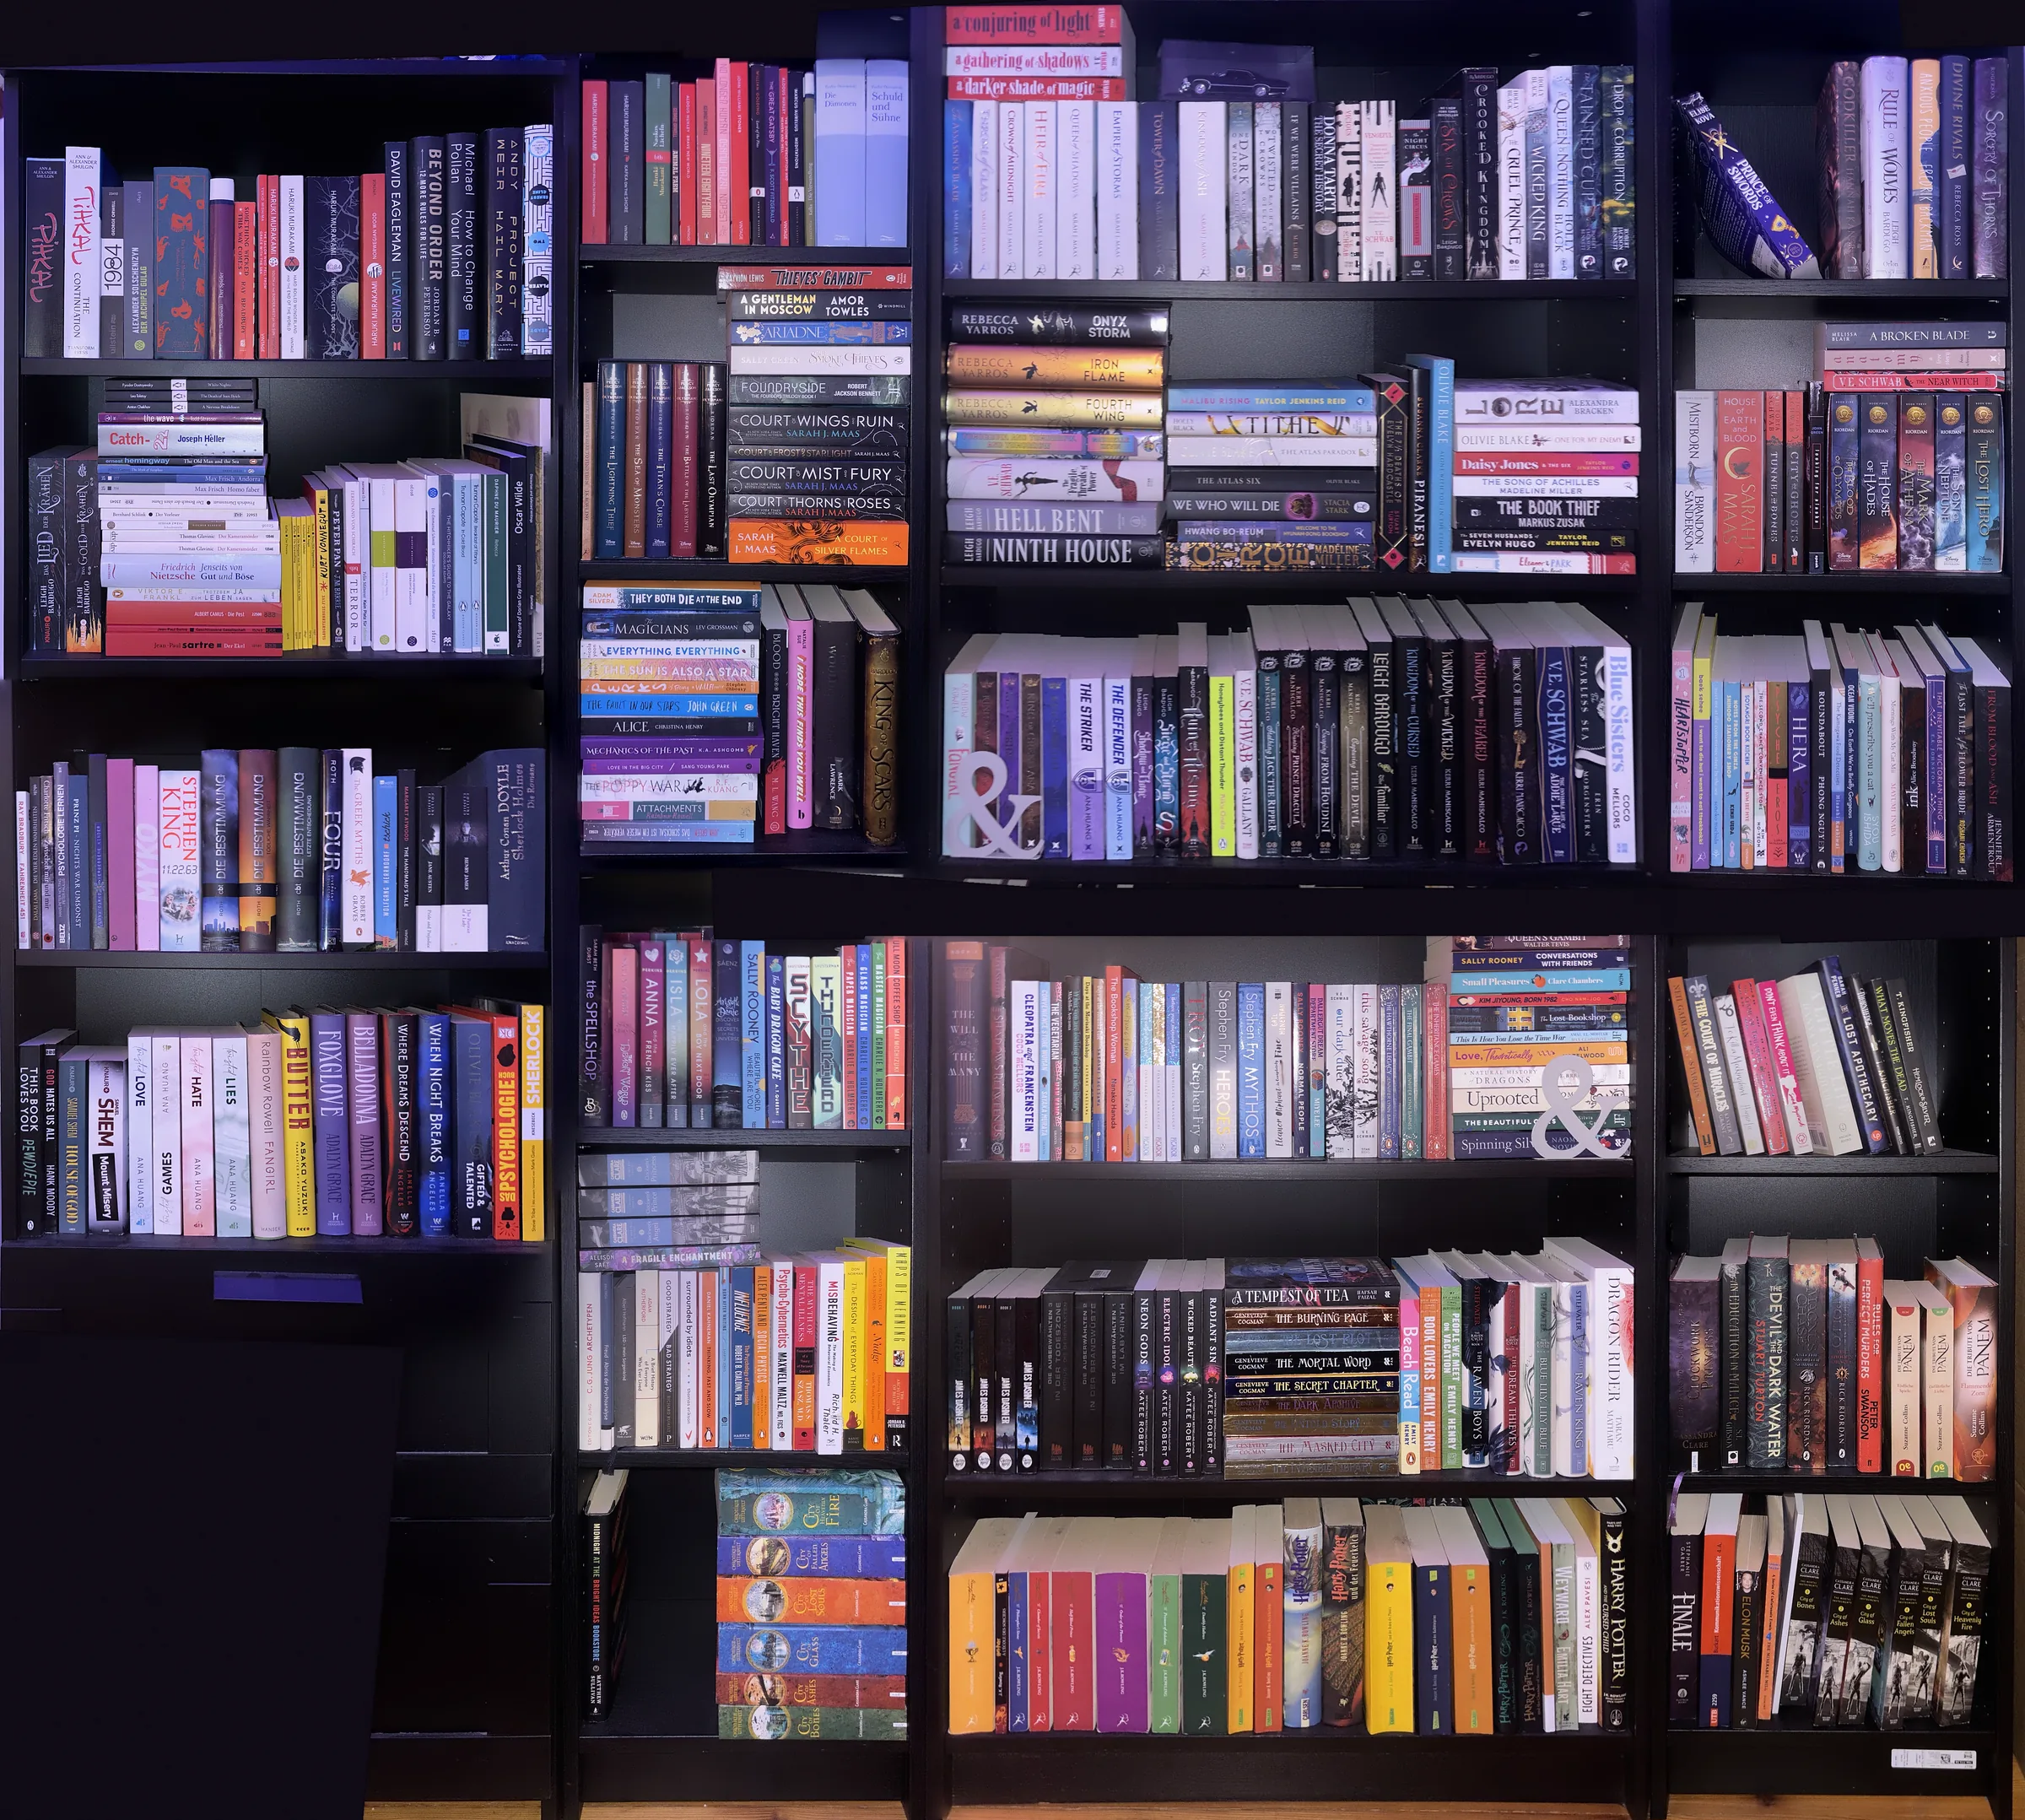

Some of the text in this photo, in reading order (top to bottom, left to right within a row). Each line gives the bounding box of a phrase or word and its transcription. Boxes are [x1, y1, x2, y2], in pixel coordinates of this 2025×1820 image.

[953, 13, 1091, 36] a conjuring of light
[872, 92, 902, 100] Schuld
[872, 102, 889, 111] und
[872, 113, 900, 122] Sühne
[1291, 127, 1298, 141] WE
[1879, 89, 1899, 204] RULE OF WOLVES
[701, 144, 710, 180] NINETEEN
[429, 149, 442, 279] BEYOND ORDER
[104, 245, 122, 289] 1984
[823, 270, 872, 287] GAMBIT
[392, 271, 401, 332] LIVEWIRED
[741, 294, 815, 304] A GENTLEMAN
[745, 305, 813, 314] IN MOSCOW
[962, 316, 1018, 324] REBECCA
[1093, 316, 1126, 327] ONYX
[764, 327, 824, 338] ARIADNE
[966, 326, 1013, 334] YARROS
[1089, 327, 1130, 338] STORM
[1870, 331, 1969, 341] A BROKEN BLADE
[742, 382, 825, 392] FOUNDRYSIDE
[1859, 377, 1901, 386] SCHWAB
[1173, 500, 1279, 510] WE WHO WILL DIE
[1413, 480, 1424, 546] PIRANESI
[1497, 500, 1600, 516] THE BOOK THIEF
[994, 538, 1131, 562] NINTH HOUSE
[630, 594, 652, 603] THEY
[655, 594, 675, 603] BOTH
[678, 594, 694, 604] DIE
[722, 596, 742, 605] END
[613, 721, 649, 732] ALICE
[1081, 683, 1092, 751] THE STRIKER
[1610, 656, 1628, 772] Blue Sisters
[870, 678, 895, 811] KING OF SCARS
[1793, 718, 1806, 772] HERA
[163, 788, 181, 848] KING
[183, 777, 196, 860] STEPHEN
[1906, 786, 1918, 807] ink
[323, 811, 341, 870] FOUR
[646, 979, 658, 1026] ANNA
[586, 980, 597, 1082] the SPELLSHOP
[790, 974, 810, 1113] SCYTHE
[319, 1031, 343, 1115] FOXGLOVE
[354, 1027, 376, 1125] BELLADONNA
[526, 1011, 540, 1104] SHERLOCK
[1843, 1017, 1877, 1122] LOST APOTHECARY
[136, 1077, 145, 1106] LOVE
[226, 1078, 236, 1104] LIES
[287, 1048, 310, 1129] BUTTER
[1217, 1071, 1230, 1134] HEROES
[1245, 1067, 1258, 1137] MYTHOS
[1467, 1089, 1539, 1112] Uprooted
[99, 1099, 114, 1146] SHEM
[499, 1080, 516, 1191] PSYCHOLOGIE
[23, 1140, 36, 1195] PEWDIEPIE
[734, 1291, 749, 1332] INFLUENCE
[778, 1270, 790, 1347] Psycho-Cybernetics
[828, 1282, 838, 1342] MISBEHAVING
[1232, 1290, 1349, 1304] A TEMPEST OF TEA
[1276, 1356, 1371, 1370] THE MORTAL WORD
[1403, 1327, 1418, 1409] Beach Read
[1870, 1401, 1878, 1428] PETER
[1556, 1566, 1573, 1623] WEYWARD
[1611, 1559, 1625, 1680] HARRY POTTER
[1672, 1591, 1696, 1651] FINALE
[1742, 1596, 1751, 1658] ELON MUSK
[1953, 1616, 1981, 1624] Heavenly
[1582, 1636, 1592, 1712] EIGHT DETECTIVES
